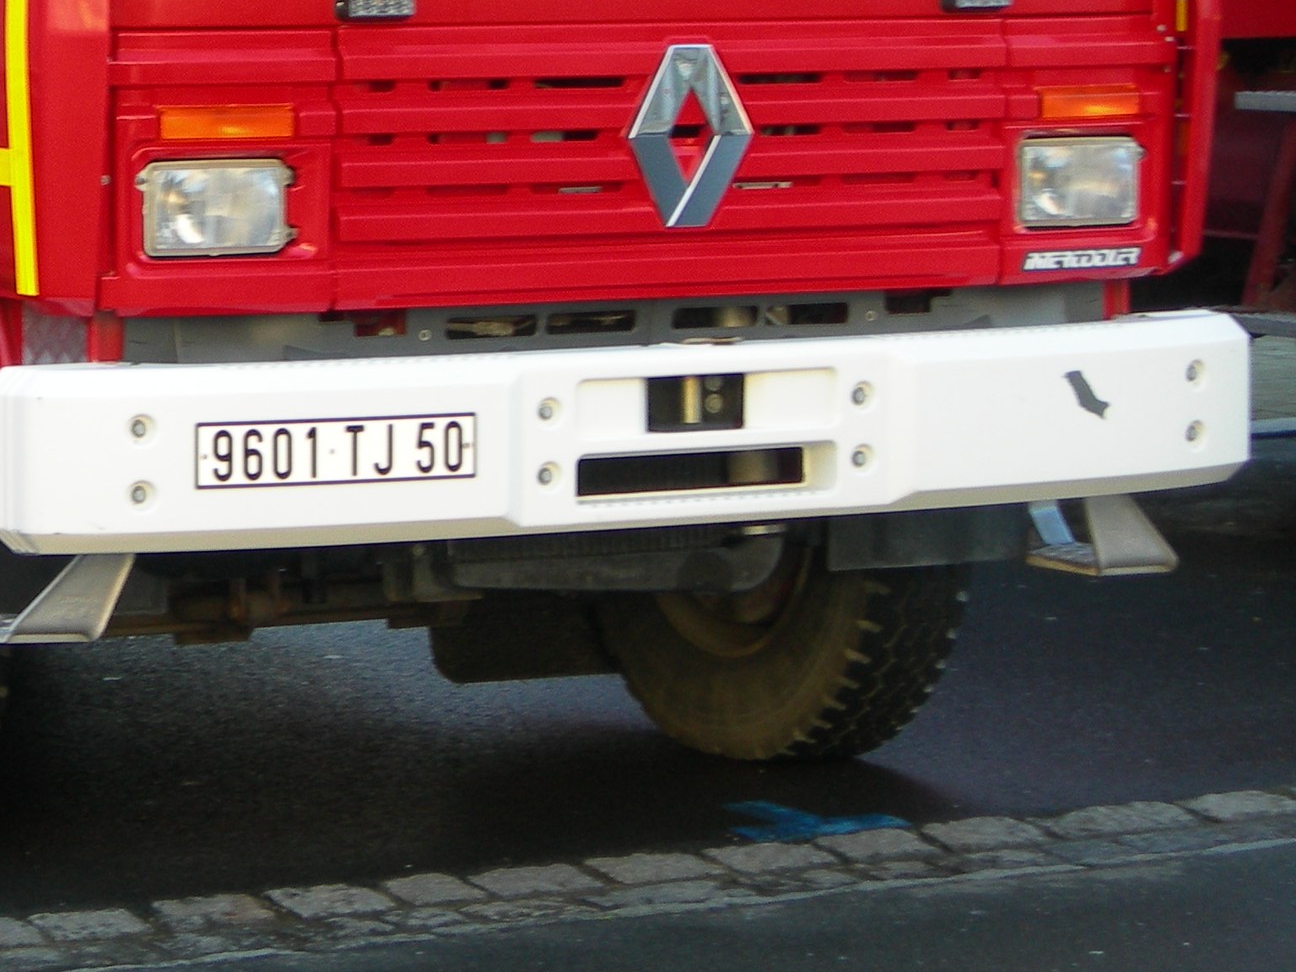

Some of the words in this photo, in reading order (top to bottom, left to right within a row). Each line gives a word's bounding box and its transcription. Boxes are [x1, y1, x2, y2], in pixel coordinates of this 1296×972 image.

[212, 426, 318, 483] 9601
[345, 423, 394, 478] TJ
[415, 420, 464, 475] 50
